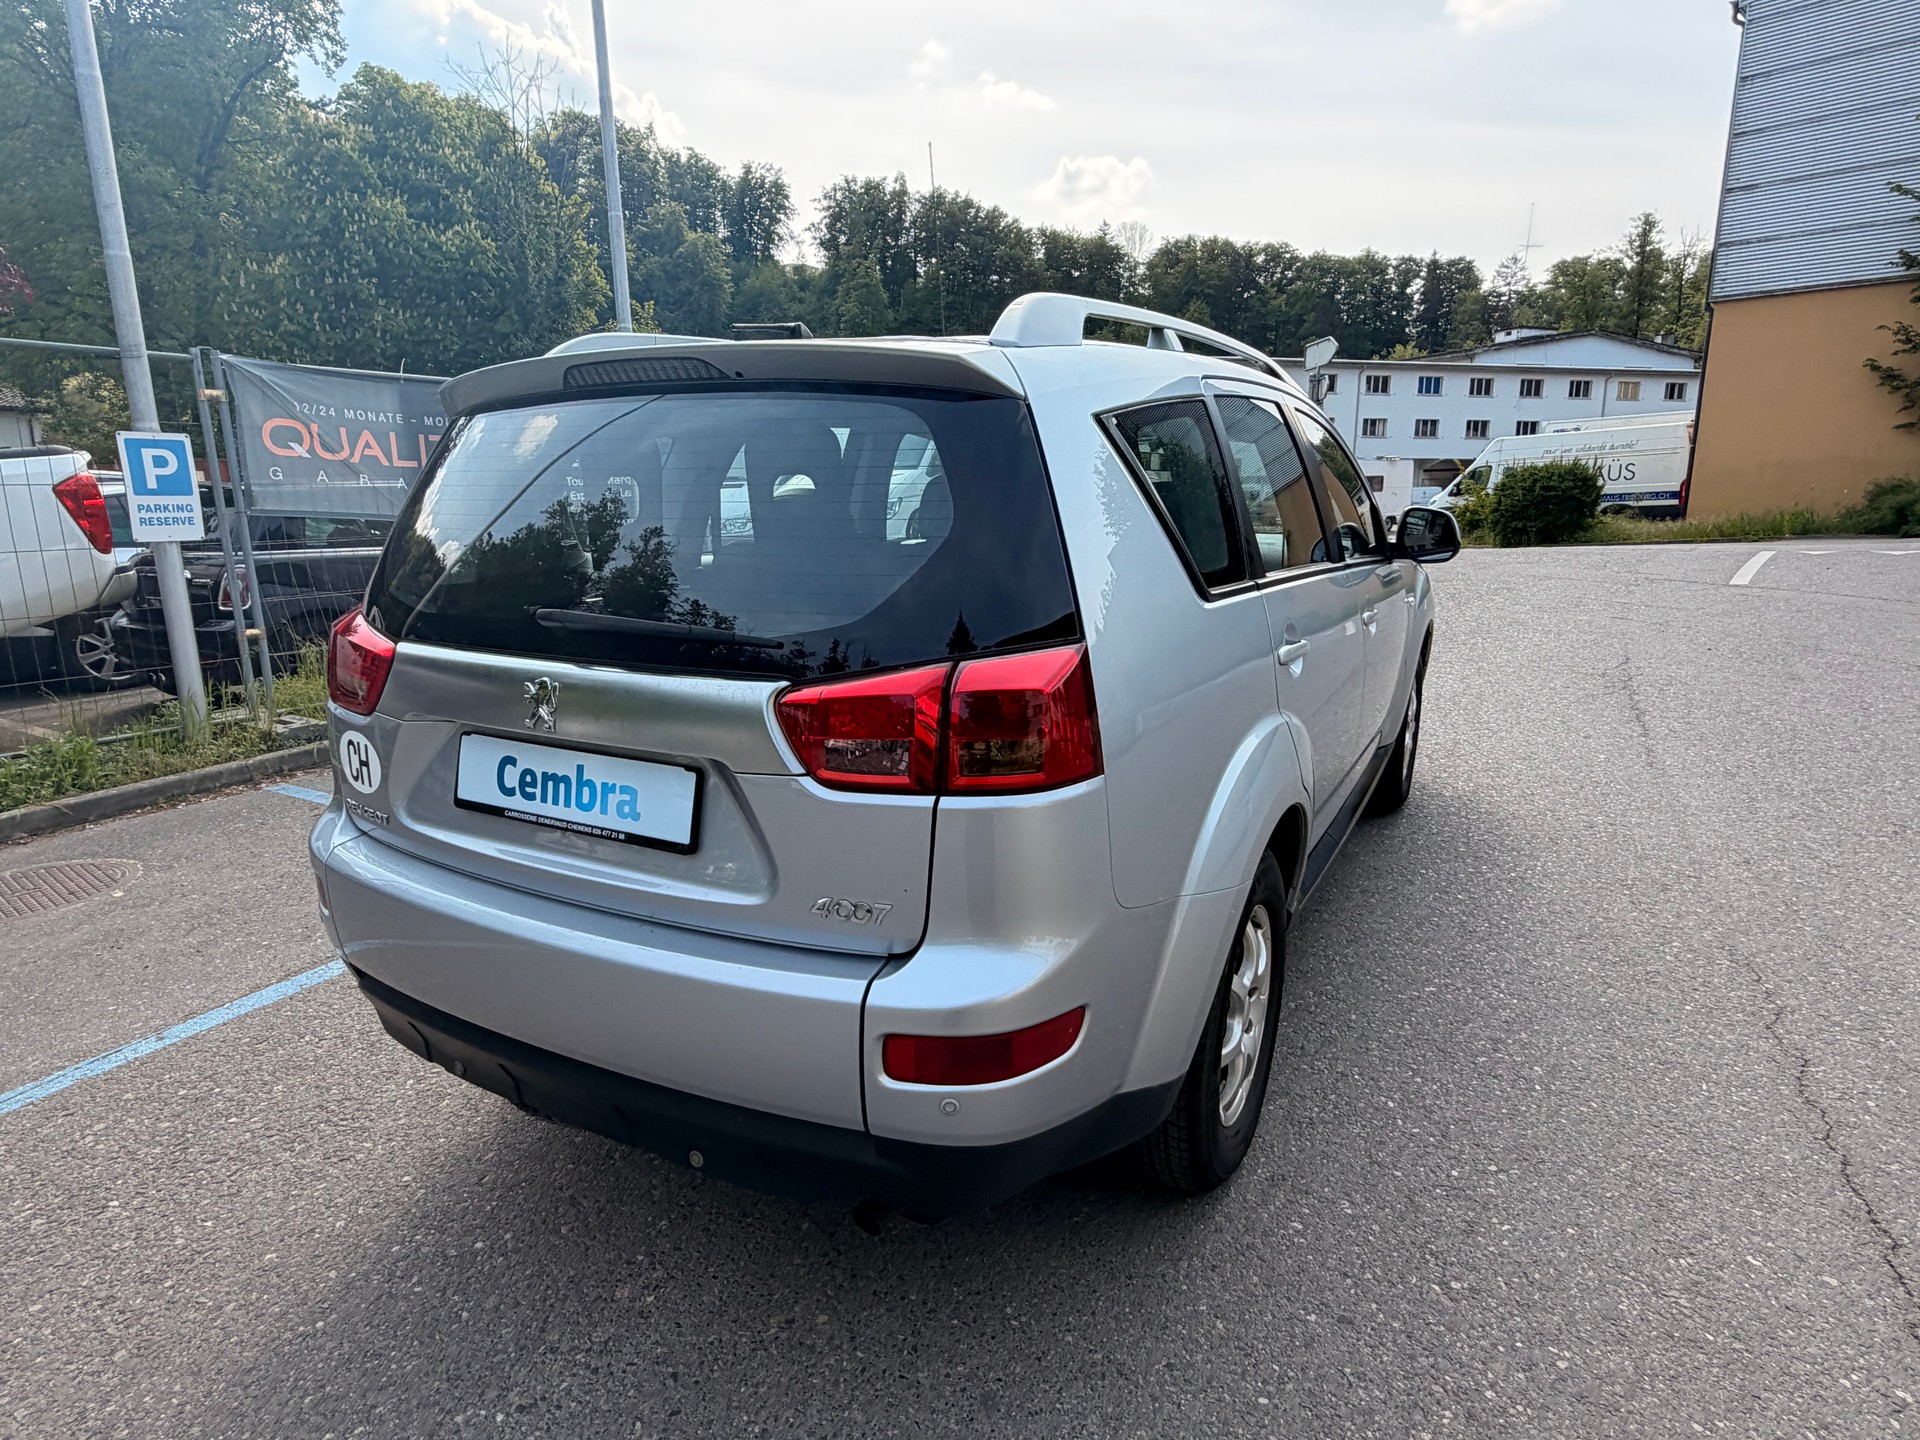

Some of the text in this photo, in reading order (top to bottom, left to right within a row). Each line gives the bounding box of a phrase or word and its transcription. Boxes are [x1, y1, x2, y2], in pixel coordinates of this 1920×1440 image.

[343, 408, 404, 424] MONATE
[141, 447, 179, 490] P
[269, 466, 408, 490] GARA
[1596, 458, 1636, 482] AÜS
[565, 476, 584, 486] Tou
[137, 503, 194, 514] PARKING
[139, 516, 196, 527] RESERVE
[346, 739, 373, 788] CH
[496, 754, 642, 822] Cembra
[809, 896, 894, 926] 4007
